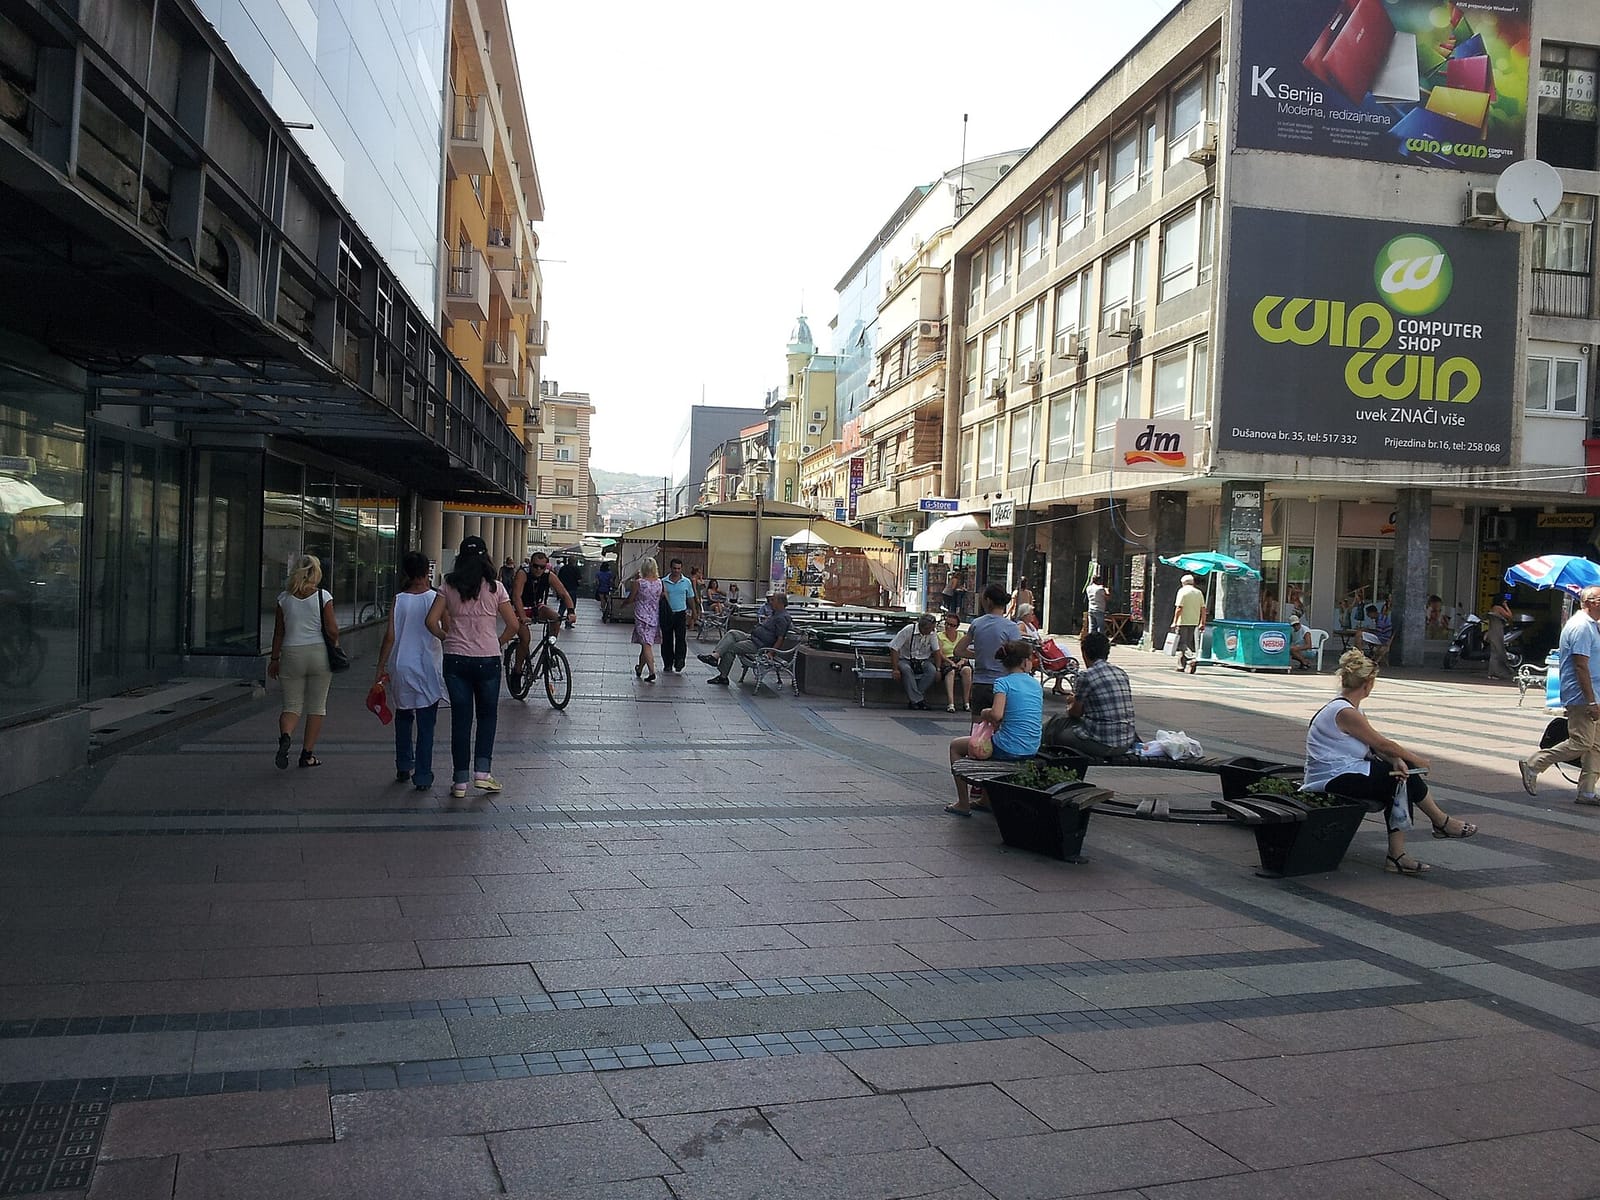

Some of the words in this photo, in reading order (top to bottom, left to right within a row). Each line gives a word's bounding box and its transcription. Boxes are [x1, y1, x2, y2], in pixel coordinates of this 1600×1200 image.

[1251, 65, 1277, 98] K
[1278, 84, 1323, 105] Serija
[1277, 102, 1326, 119] Moderna,
[1329, 109, 1391, 125] redizajnirana
[1488, 147, 1514, 156] COMPUTER
[1398, 319, 1483, 339] COMPUTER
[1398, 336, 1442, 352] SHOP
[1356, 408, 1388, 422] uvek
[1390, 406, 1438, 424] ZNAČI
[1440, 413, 1466, 427] više
[1135, 424, 1181, 452] dm
[1232, 427, 1277, 440] Dušanova
[1278, 430, 1291, 441] br.
[1292, 431, 1305, 442] 35,
[1307, 433, 1321, 443] tel:
[1322, 434, 1339, 443] 517
[1340, 435, 1358, 445] 332
[1384, 437, 1426, 449] Prijezdina
[1452, 441, 1466, 451] tel:
[1467, 442, 1483, 452] 258
[1484, 443, 1501, 453] 068
[925, 501, 952, 511] G-Store
